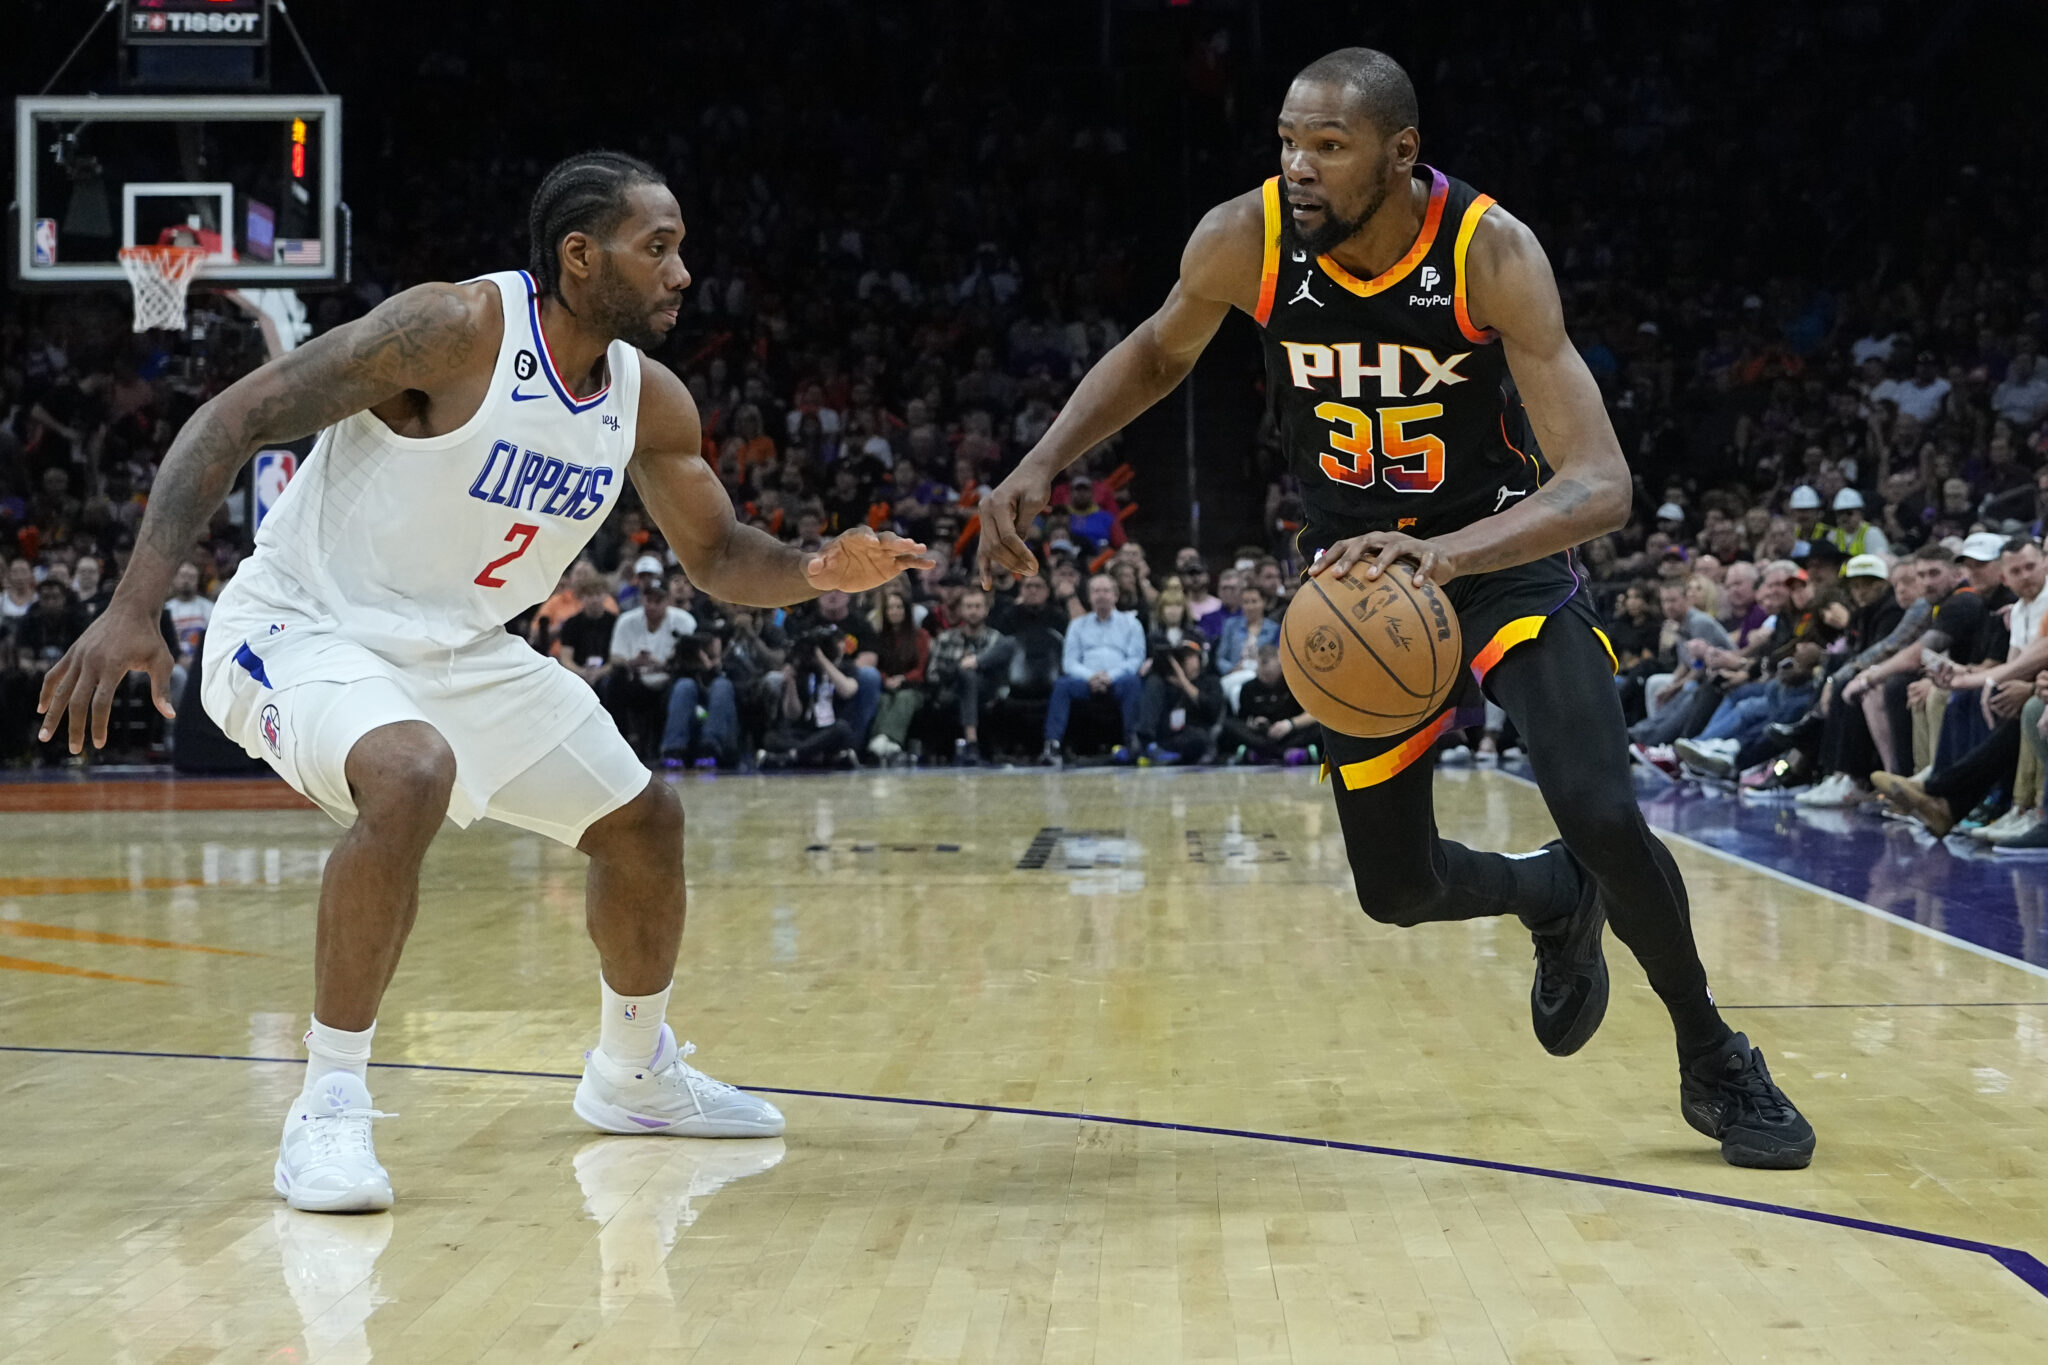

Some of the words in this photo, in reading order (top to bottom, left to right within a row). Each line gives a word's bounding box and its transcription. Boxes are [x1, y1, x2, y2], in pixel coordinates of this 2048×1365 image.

[167, 12, 259, 32] TISSOT
[1409, 294, 1452, 308] PayPal
[517, 353, 532, 378] 6
[1280, 341, 1472, 398] PHX
[1314, 402, 1446, 493] 35
[468, 439, 613, 521] CLIPPERS
[473, 522, 540, 588] 2
